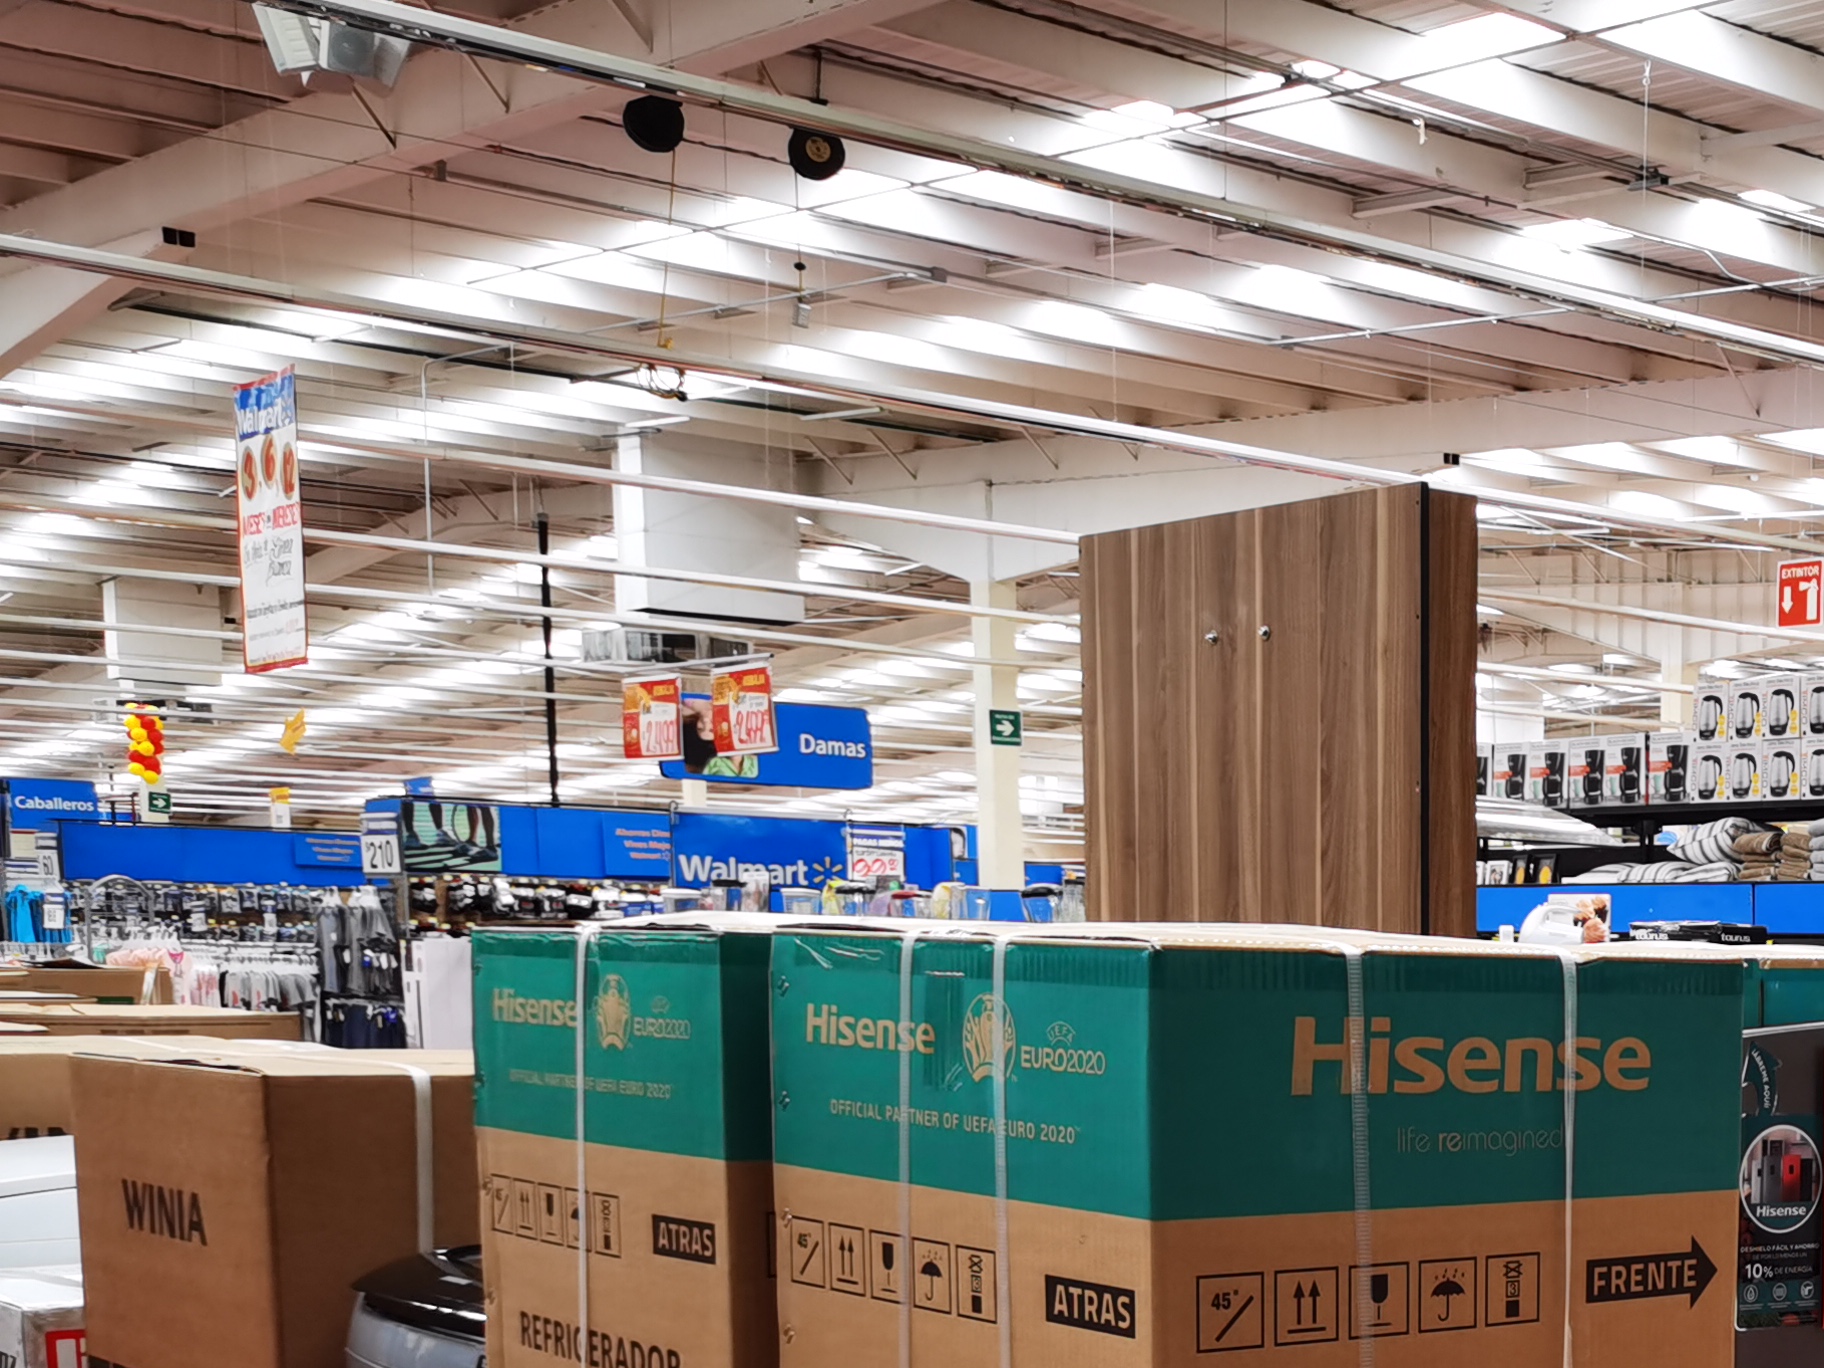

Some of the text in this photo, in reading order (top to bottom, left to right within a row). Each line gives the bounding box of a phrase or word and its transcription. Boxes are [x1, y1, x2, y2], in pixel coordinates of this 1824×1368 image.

[1781, 565, 1820, 580] EXTINTOR
[799, 733, 867, 758] Damas
[14, 795, 95, 813] Caballeros
[678, 853, 810, 888] Walmart
[1635, 931, 1669, 941] taurus
[1721, 932, 1750, 942] taurus
[493, 986, 578, 1028] Hisense
[806, 1003, 936, 1055] Hisense
[1020, 1045, 1106, 1075] EURO2020
[1291, 1015, 1652, 1096] Hisense
[830, 1098, 883, 1121] OFFICIAL
[943, 1112, 960, 1130] OF
[963, 1113, 995, 1134] UEFA
[1040, 1123, 1076, 1145] 2020
[1397, 1125, 1563, 1157] life reimagined
[121, 1178, 208, 1247] WINIA
[1755, 1204, 1807, 1219] Hisense
[658, 1221, 714, 1258] ATRAS
[1593, 1258, 1698, 1297] FRENTE
[1745, 1262, 1774, 1280] 10%
[1052, 1283, 1131, 1330] ATRAS
